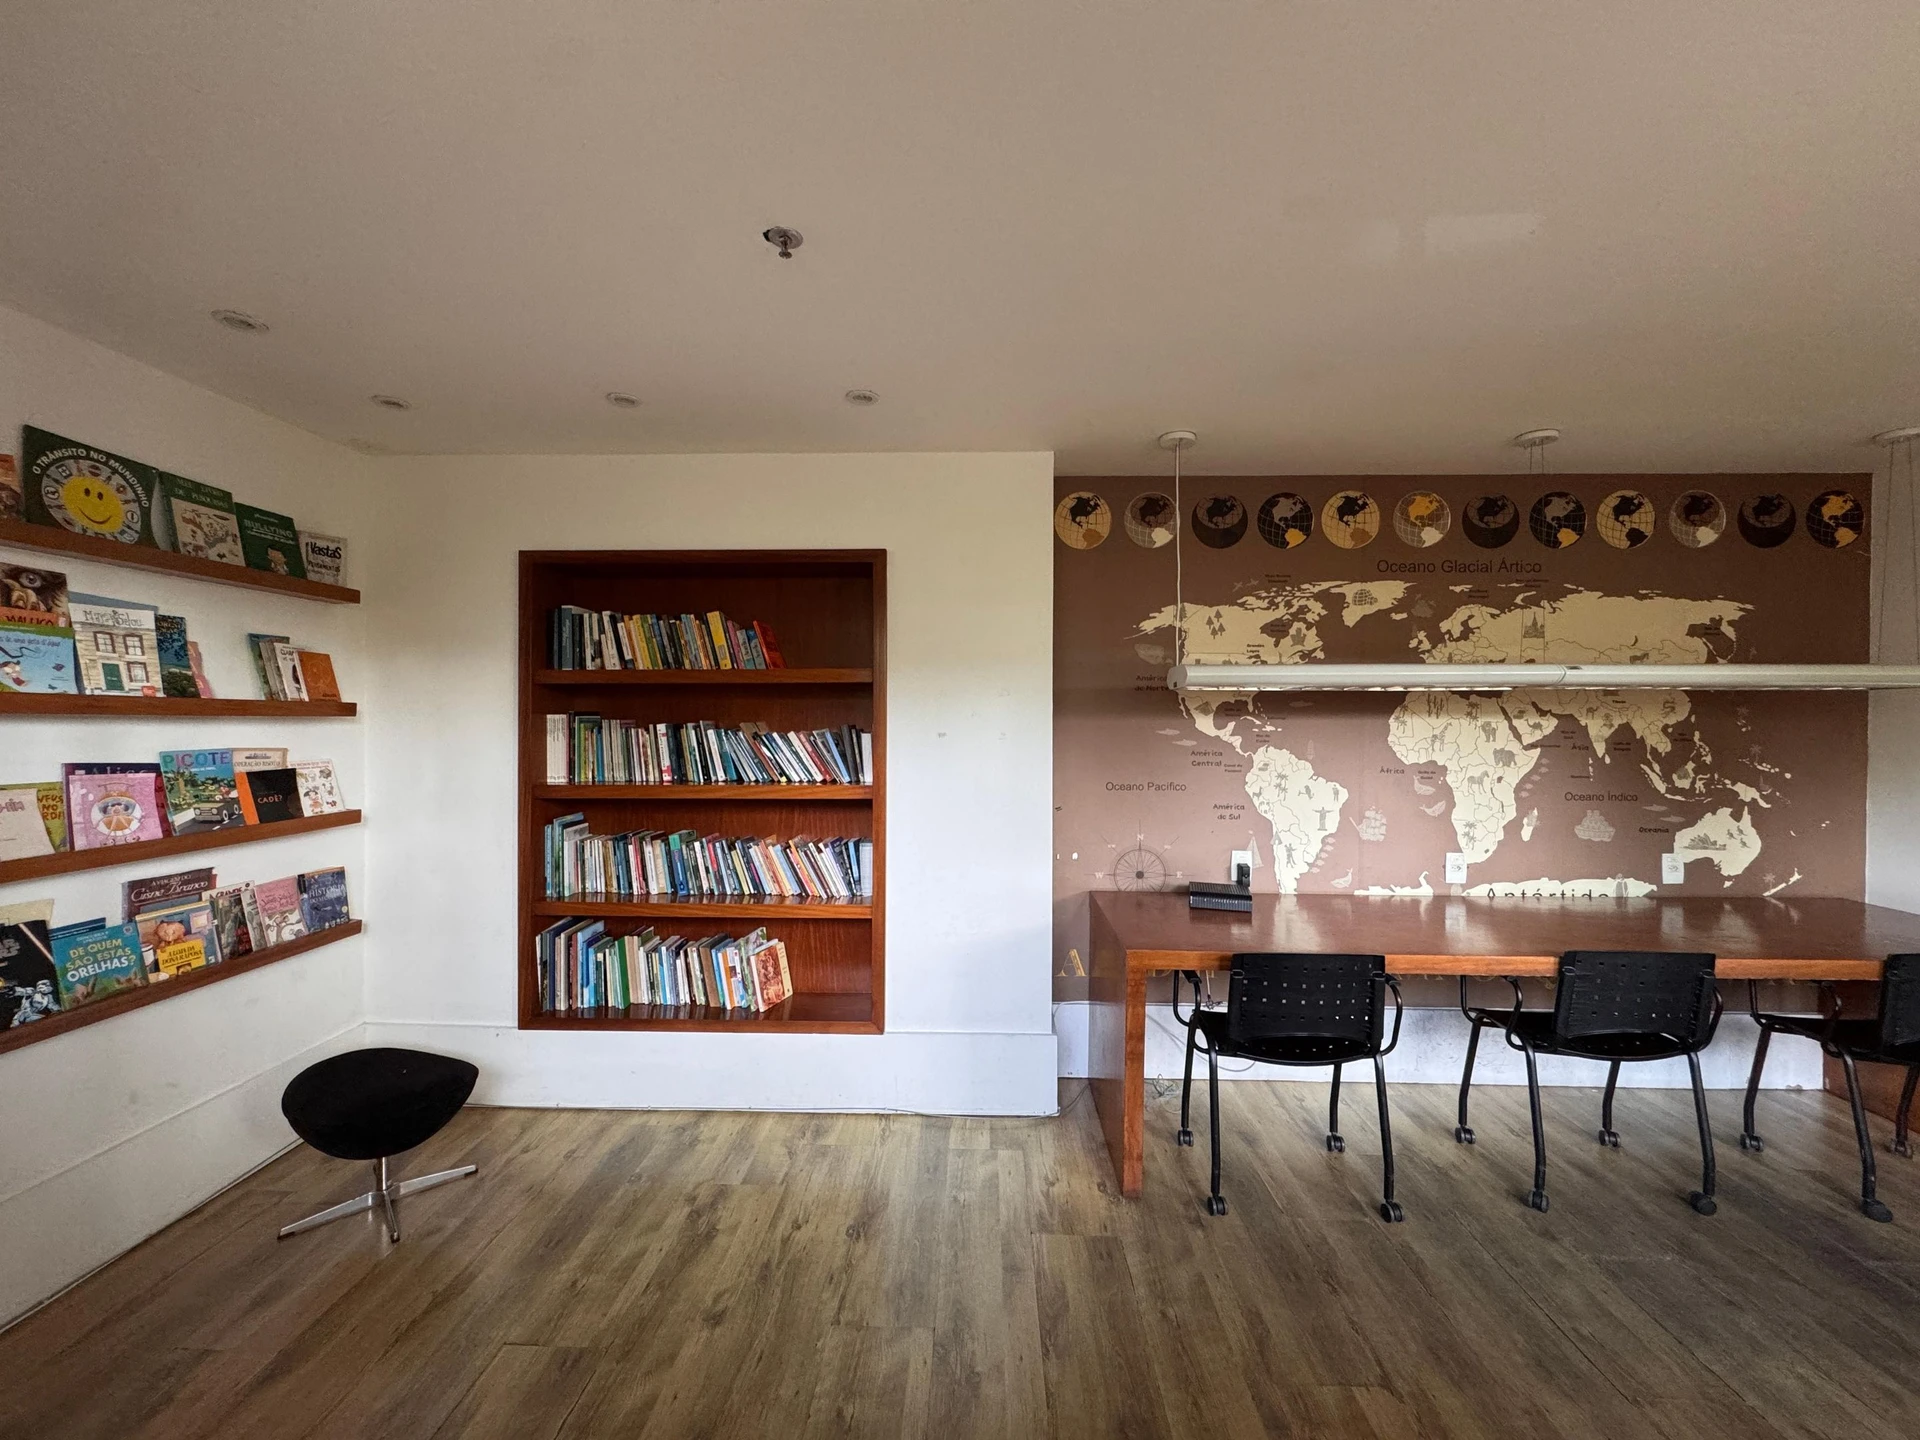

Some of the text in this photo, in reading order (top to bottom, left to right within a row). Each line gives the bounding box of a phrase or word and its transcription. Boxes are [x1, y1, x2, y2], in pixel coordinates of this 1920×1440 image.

[32, 466, 42, 475] O
[90, 450, 107, 462] NO
[108, 459, 150, 508] MUNDINHO
[244, 519, 294, 539] BULLYING
[1376, 557, 1542, 573] Oceano Glacial Ártico
[1190, 749, 1223, 757] América
[1571, 743, 1590, 752] Ásia
[162, 751, 231, 769] PICOTE
[1191, 760, 1222, 768] Central
[1379, 765, 1405, 775] África
[1105, 781, 1187, 792] Oceano Pacífico
[257, 793, 283, 804] CADÊ?
[1564, 790, 1638, 802] Oceano Índico
[1213, 803, 1245, 811] América
[1228, 813, 1241, 821] Sul
[1638, 826, 1669, 834] Oceania
[1136, 833, 1145, 842] N
[1094, 871, 1185, 880] W E
[131, 880, 209, 902] Cisne Branco
[70, 938, 122, 958] DE QUEM
[66, 947, 132, 971] SÃO ESTAS
[66, 954, 137, 982] ORELHAS?
